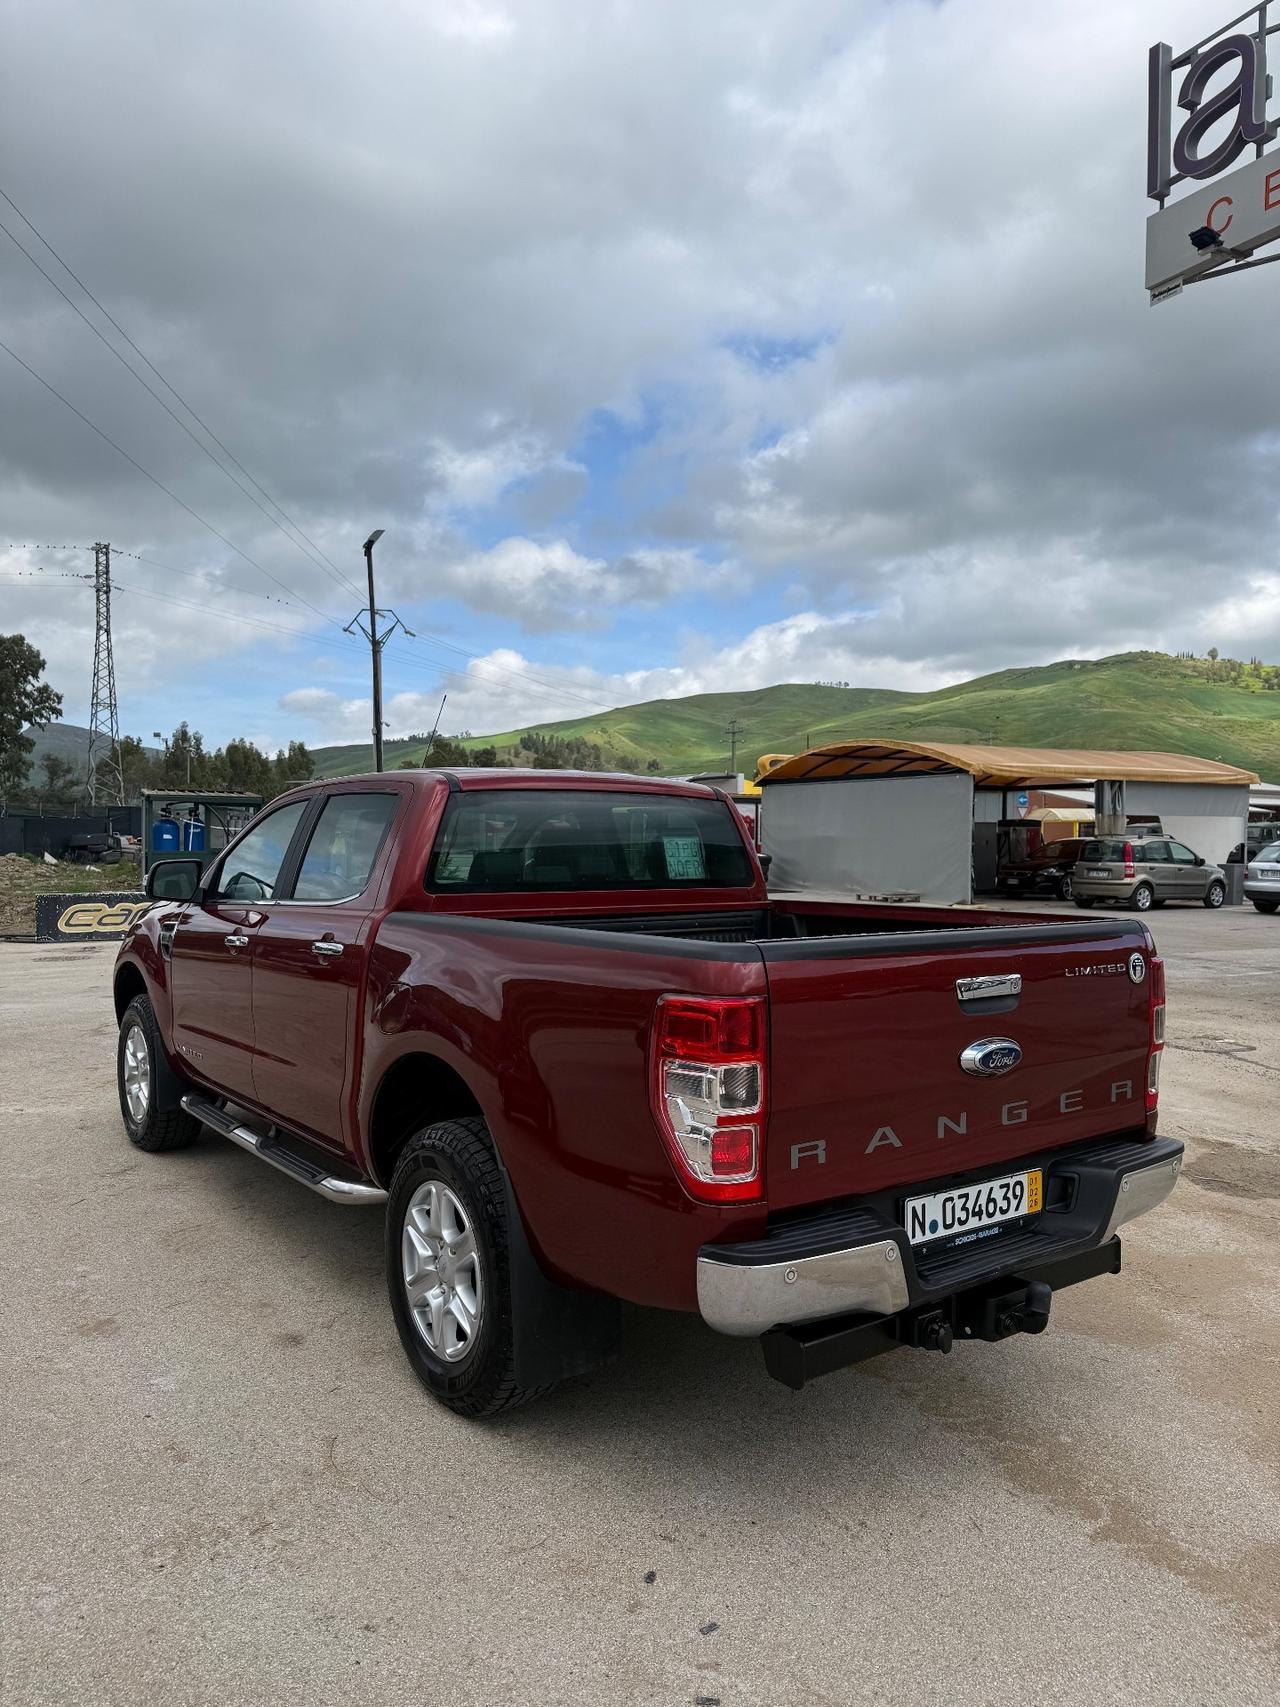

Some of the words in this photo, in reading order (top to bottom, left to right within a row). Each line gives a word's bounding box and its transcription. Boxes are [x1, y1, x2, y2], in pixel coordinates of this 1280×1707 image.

[1065, 963, 1127, 977] LIMITED
[989, 1049, 1016, 1068] Ford
[790, 1079, 1133, 1170] RANGER
[911, 1202, 927, 1240] N
[941, 1180, 1025, 1231] 034639
